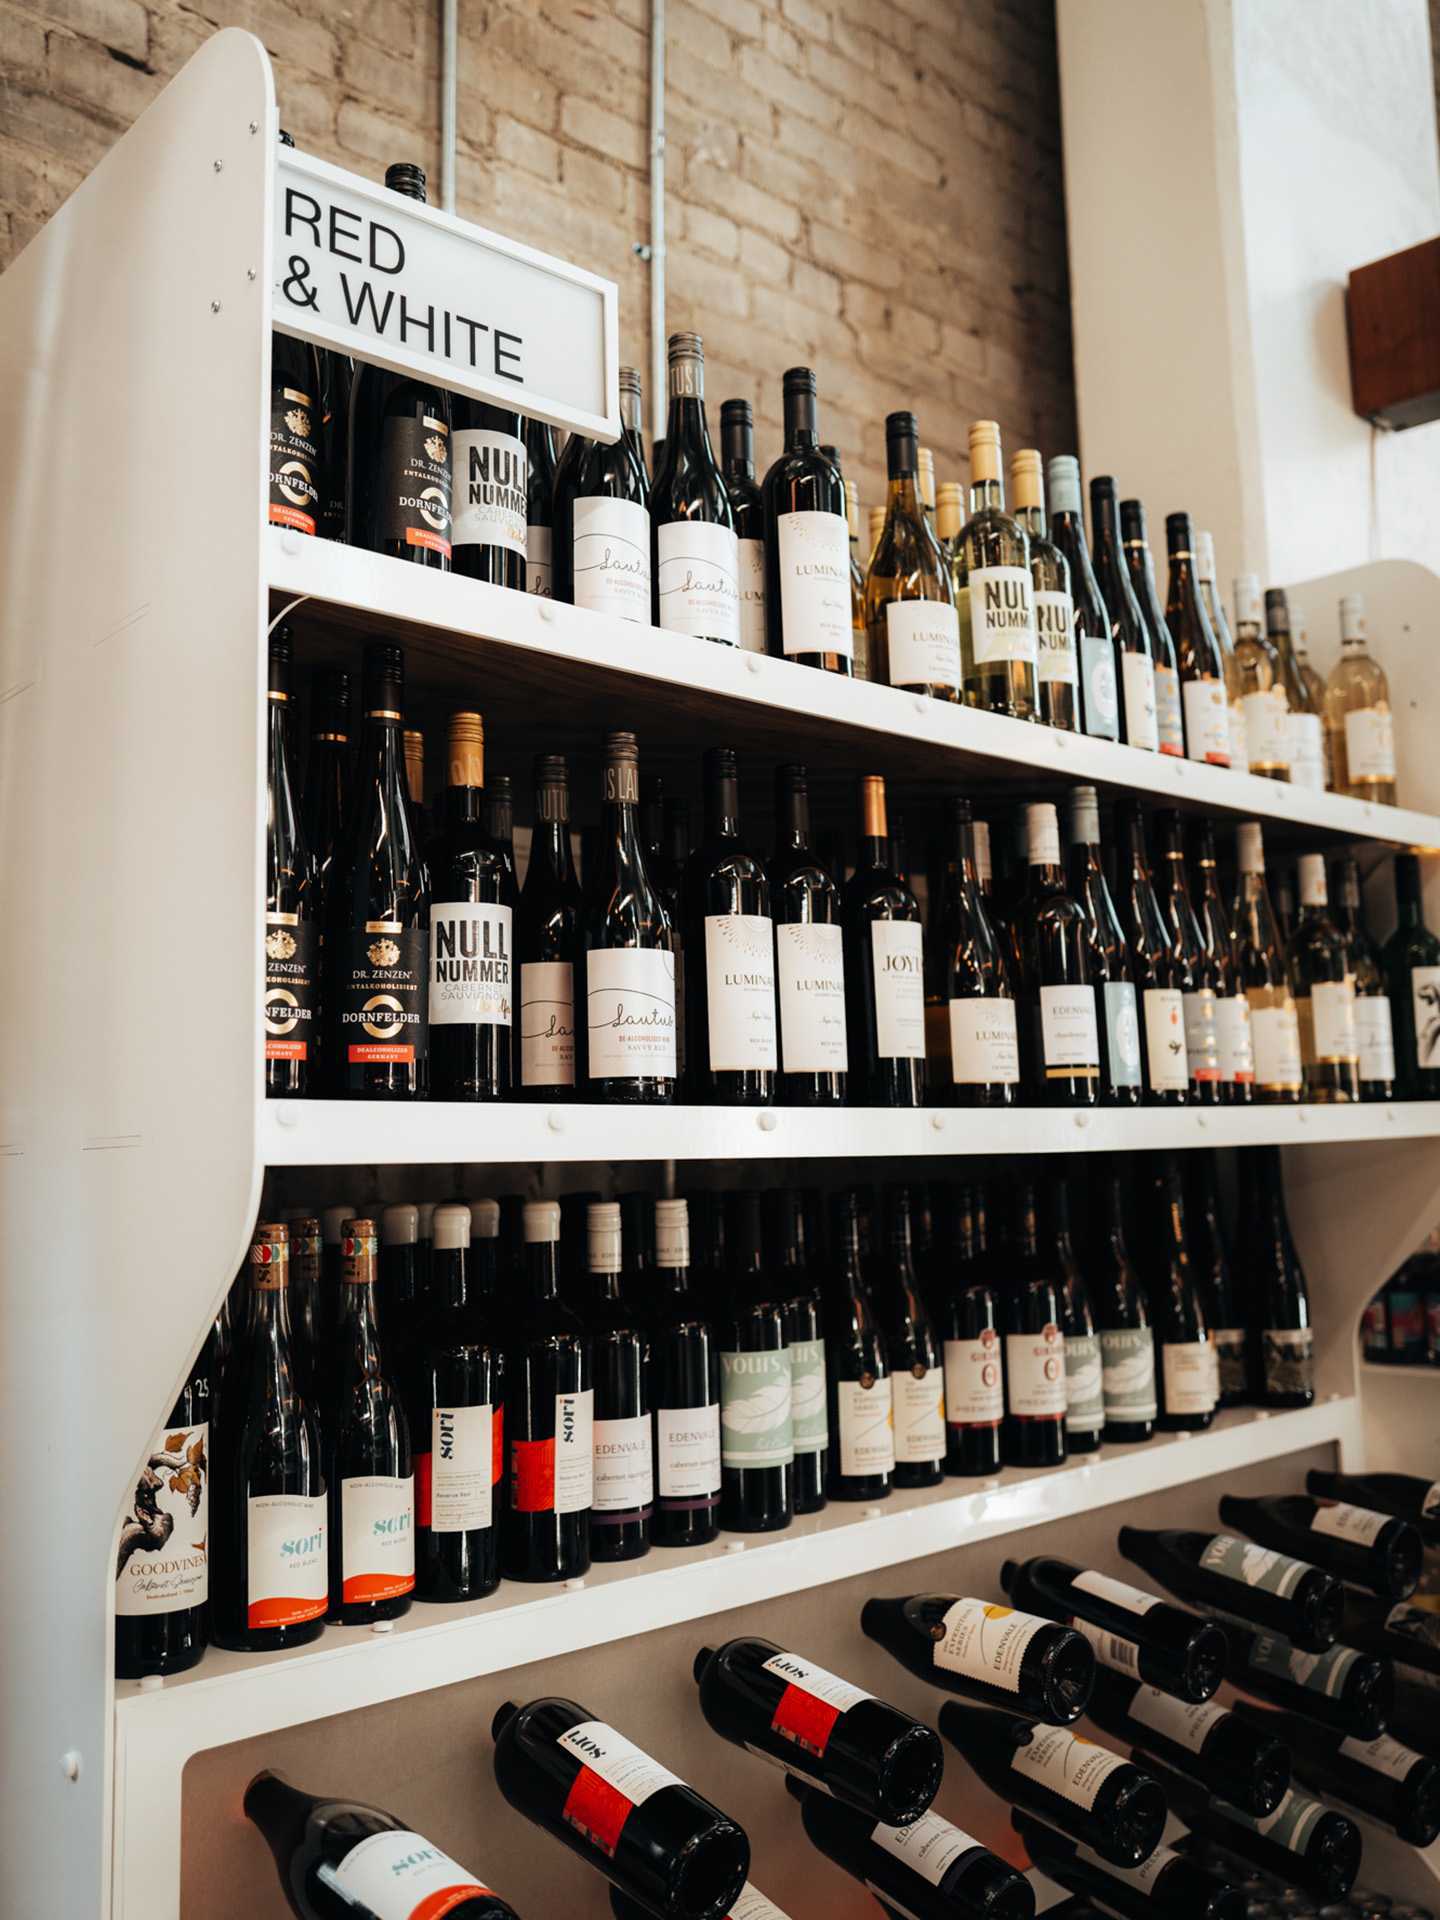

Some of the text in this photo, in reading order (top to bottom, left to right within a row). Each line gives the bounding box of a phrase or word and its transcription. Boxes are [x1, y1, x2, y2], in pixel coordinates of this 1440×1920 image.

[285, 186, 406, 275] RED
[282, 255, 525, 384] & WHITE
[985, 580, 1029, 612] NUL
[436, 919, 509, 961] NULL
[437, 959, 510, 984] NUMMER
[343, 1011, 421, 1024] DORNFELDER
[436, 1412, 455, 1460] sori
[373, 1506, 412, 1537] sori
[281, 1526, 323, 1556] sori
[563, 1730, 607, 1758] sori
